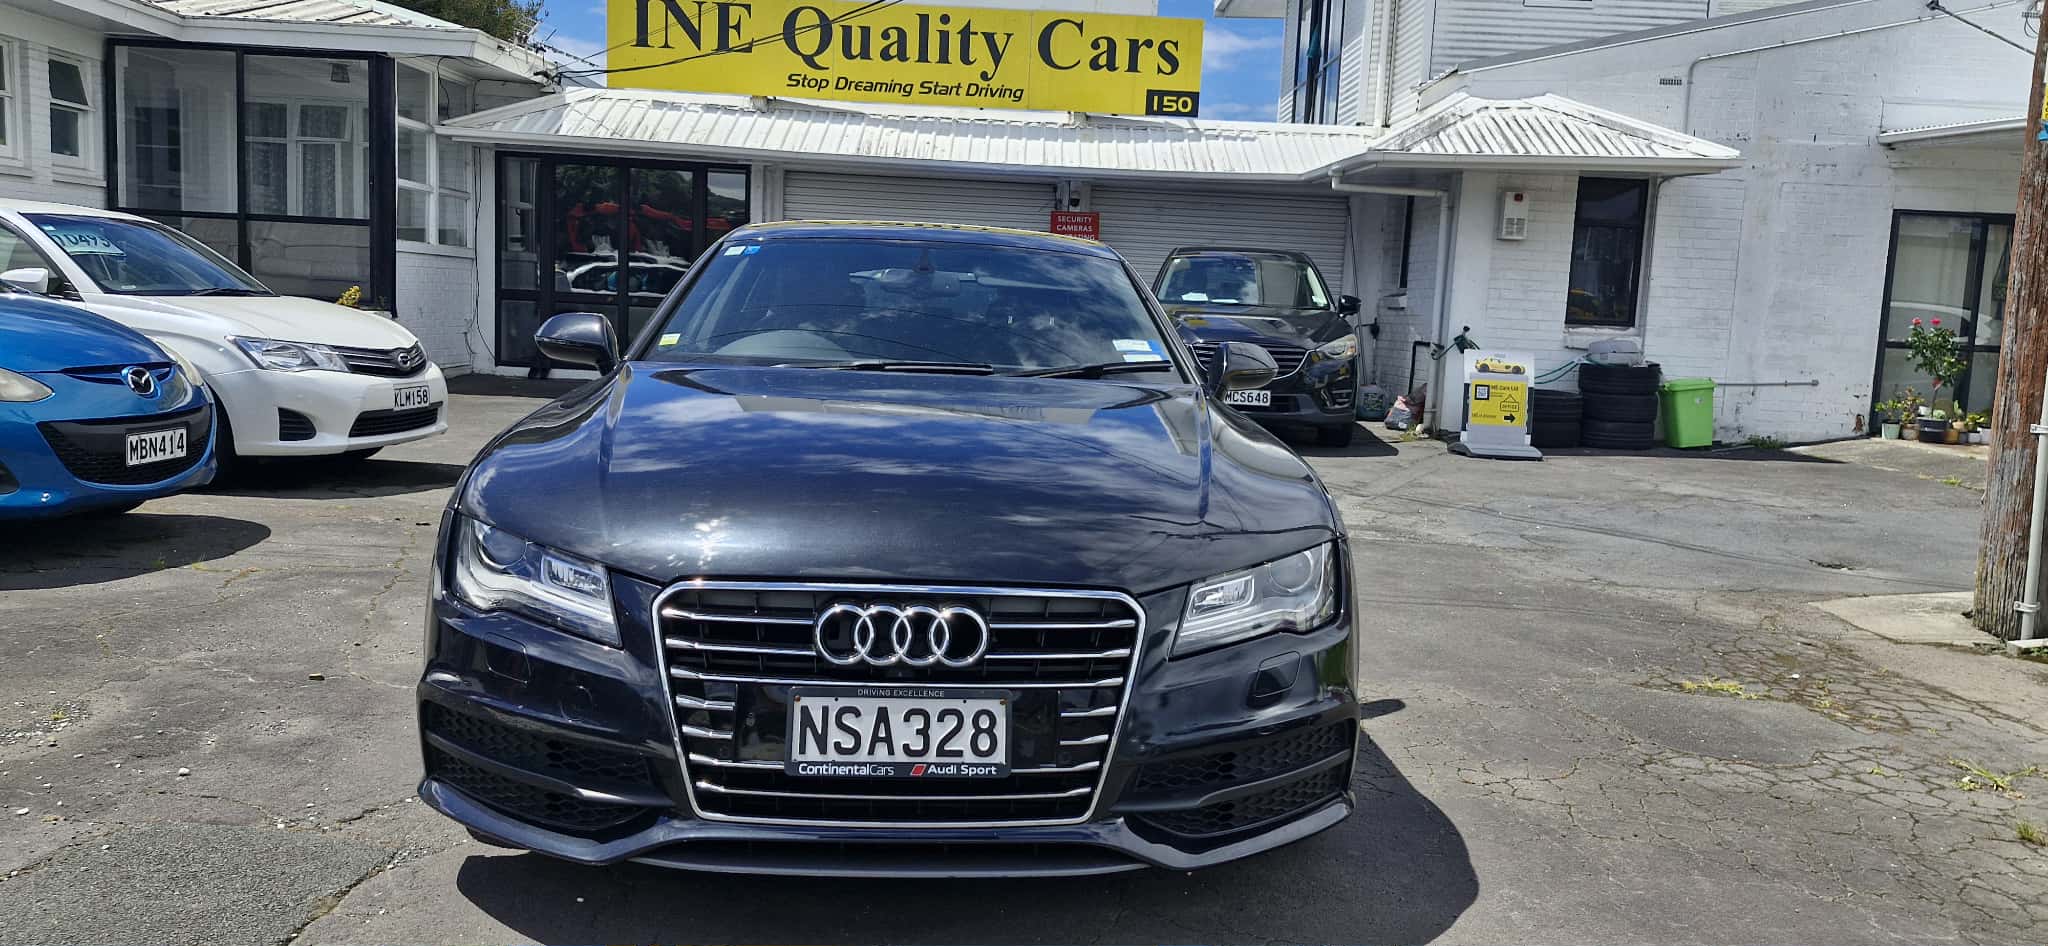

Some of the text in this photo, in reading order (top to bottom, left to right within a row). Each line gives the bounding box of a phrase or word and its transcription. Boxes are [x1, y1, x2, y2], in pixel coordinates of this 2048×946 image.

[630, 0, 1180, 81] INE Quality Cars
[787, 73, 1024, 102] Stop Dreaming Start Driving
[1152, 96, 1193, 113] 150
[1057, 215, 1092, 223] SECURITY
[1056, 224, 1093, 232] CAMERAS
[394, 389, 429, 408] KLM158
[1225, 391, 1269, 404] MCS648
[129, 432, 185, 462] MBN414
[857, 688, 945, 698] DRIVING EXCELLENCE
[798, 705, 998, 758] NSA328
[928, 764, 957, 775] Audi
[960, 764, 998, 777] Sport
